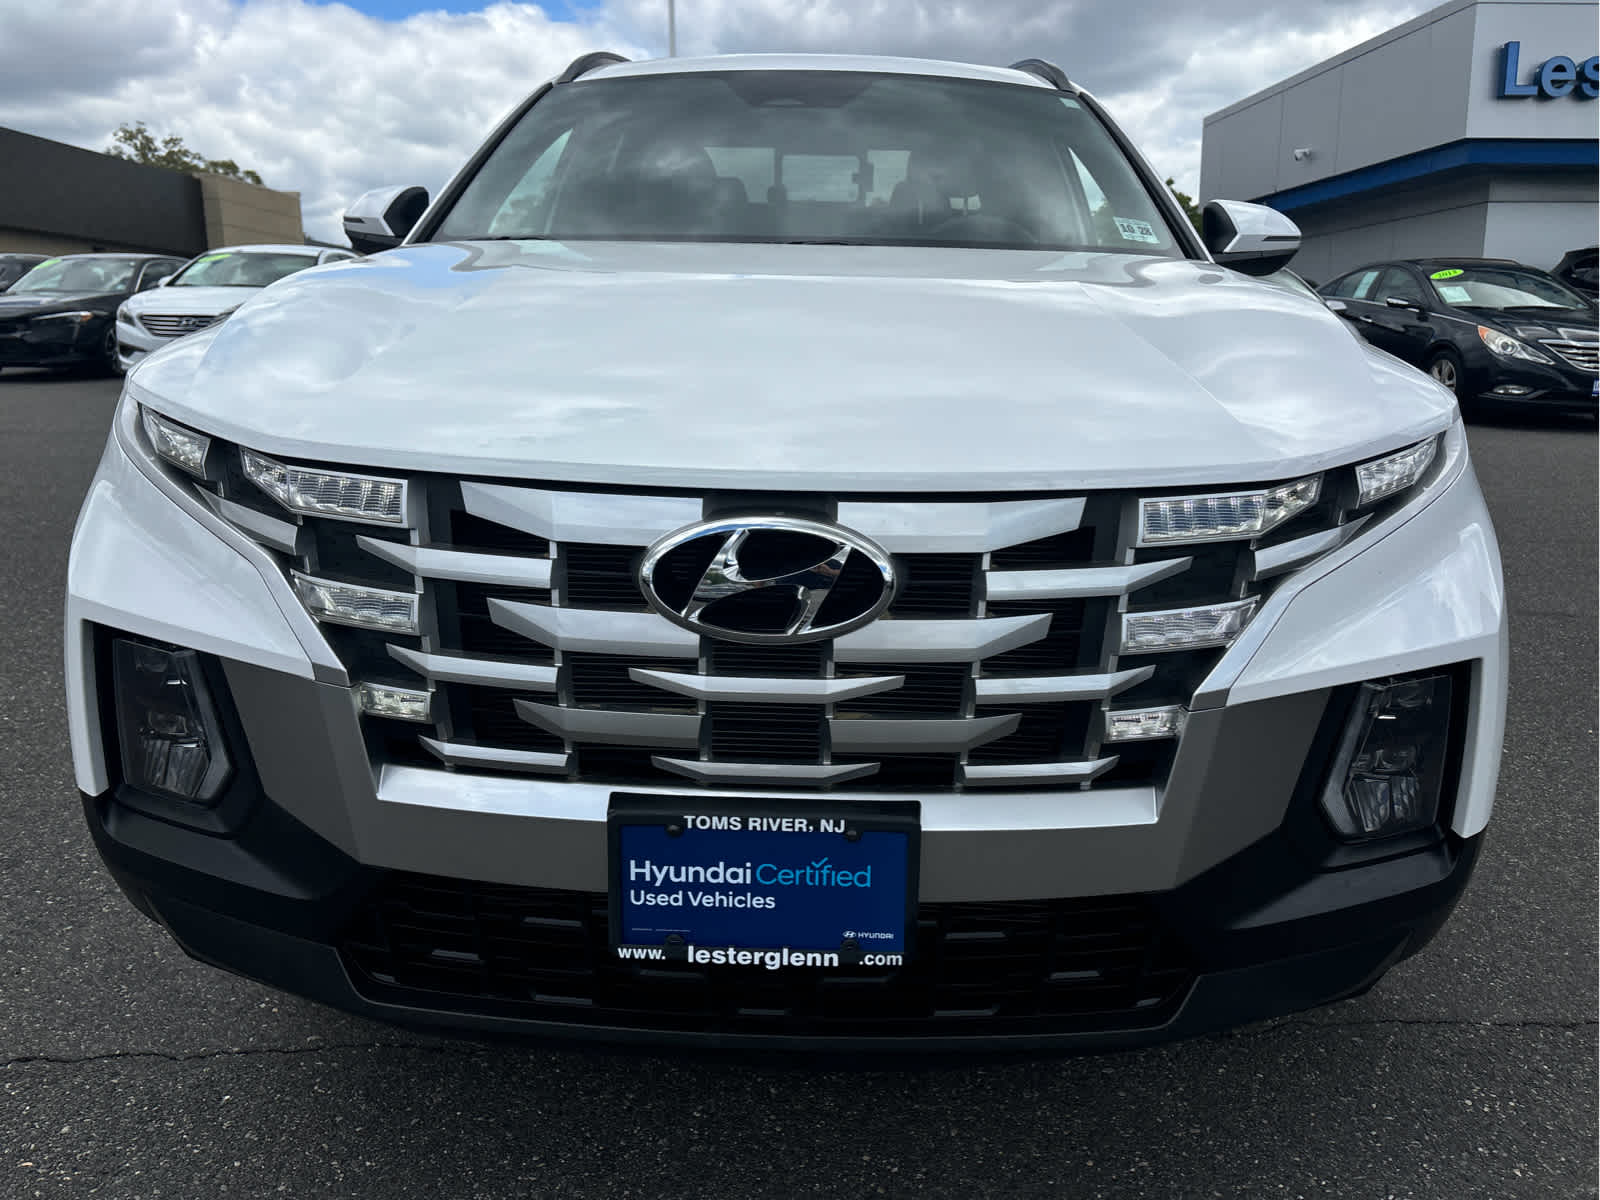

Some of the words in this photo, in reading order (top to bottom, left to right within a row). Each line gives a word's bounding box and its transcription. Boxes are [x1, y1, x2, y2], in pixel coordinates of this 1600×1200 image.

[684, 815, 742, 831] TOMS
[748, 817, 814, 833] RIVER,
[820, 819, 846, 833] NJ
[630, 860, 752, 887] Hyundai
[756, 857, 872, 888] Certified
[630, 890, 684, 906] Used
[688, 891, 776, 909] Vehicles
[857, 931, 895, 940] HYUNDAI
[617, 947, 666, 960] www.
[687, 945, 839, 970] lesterglenn
[858, 953, 903, 966] .com
